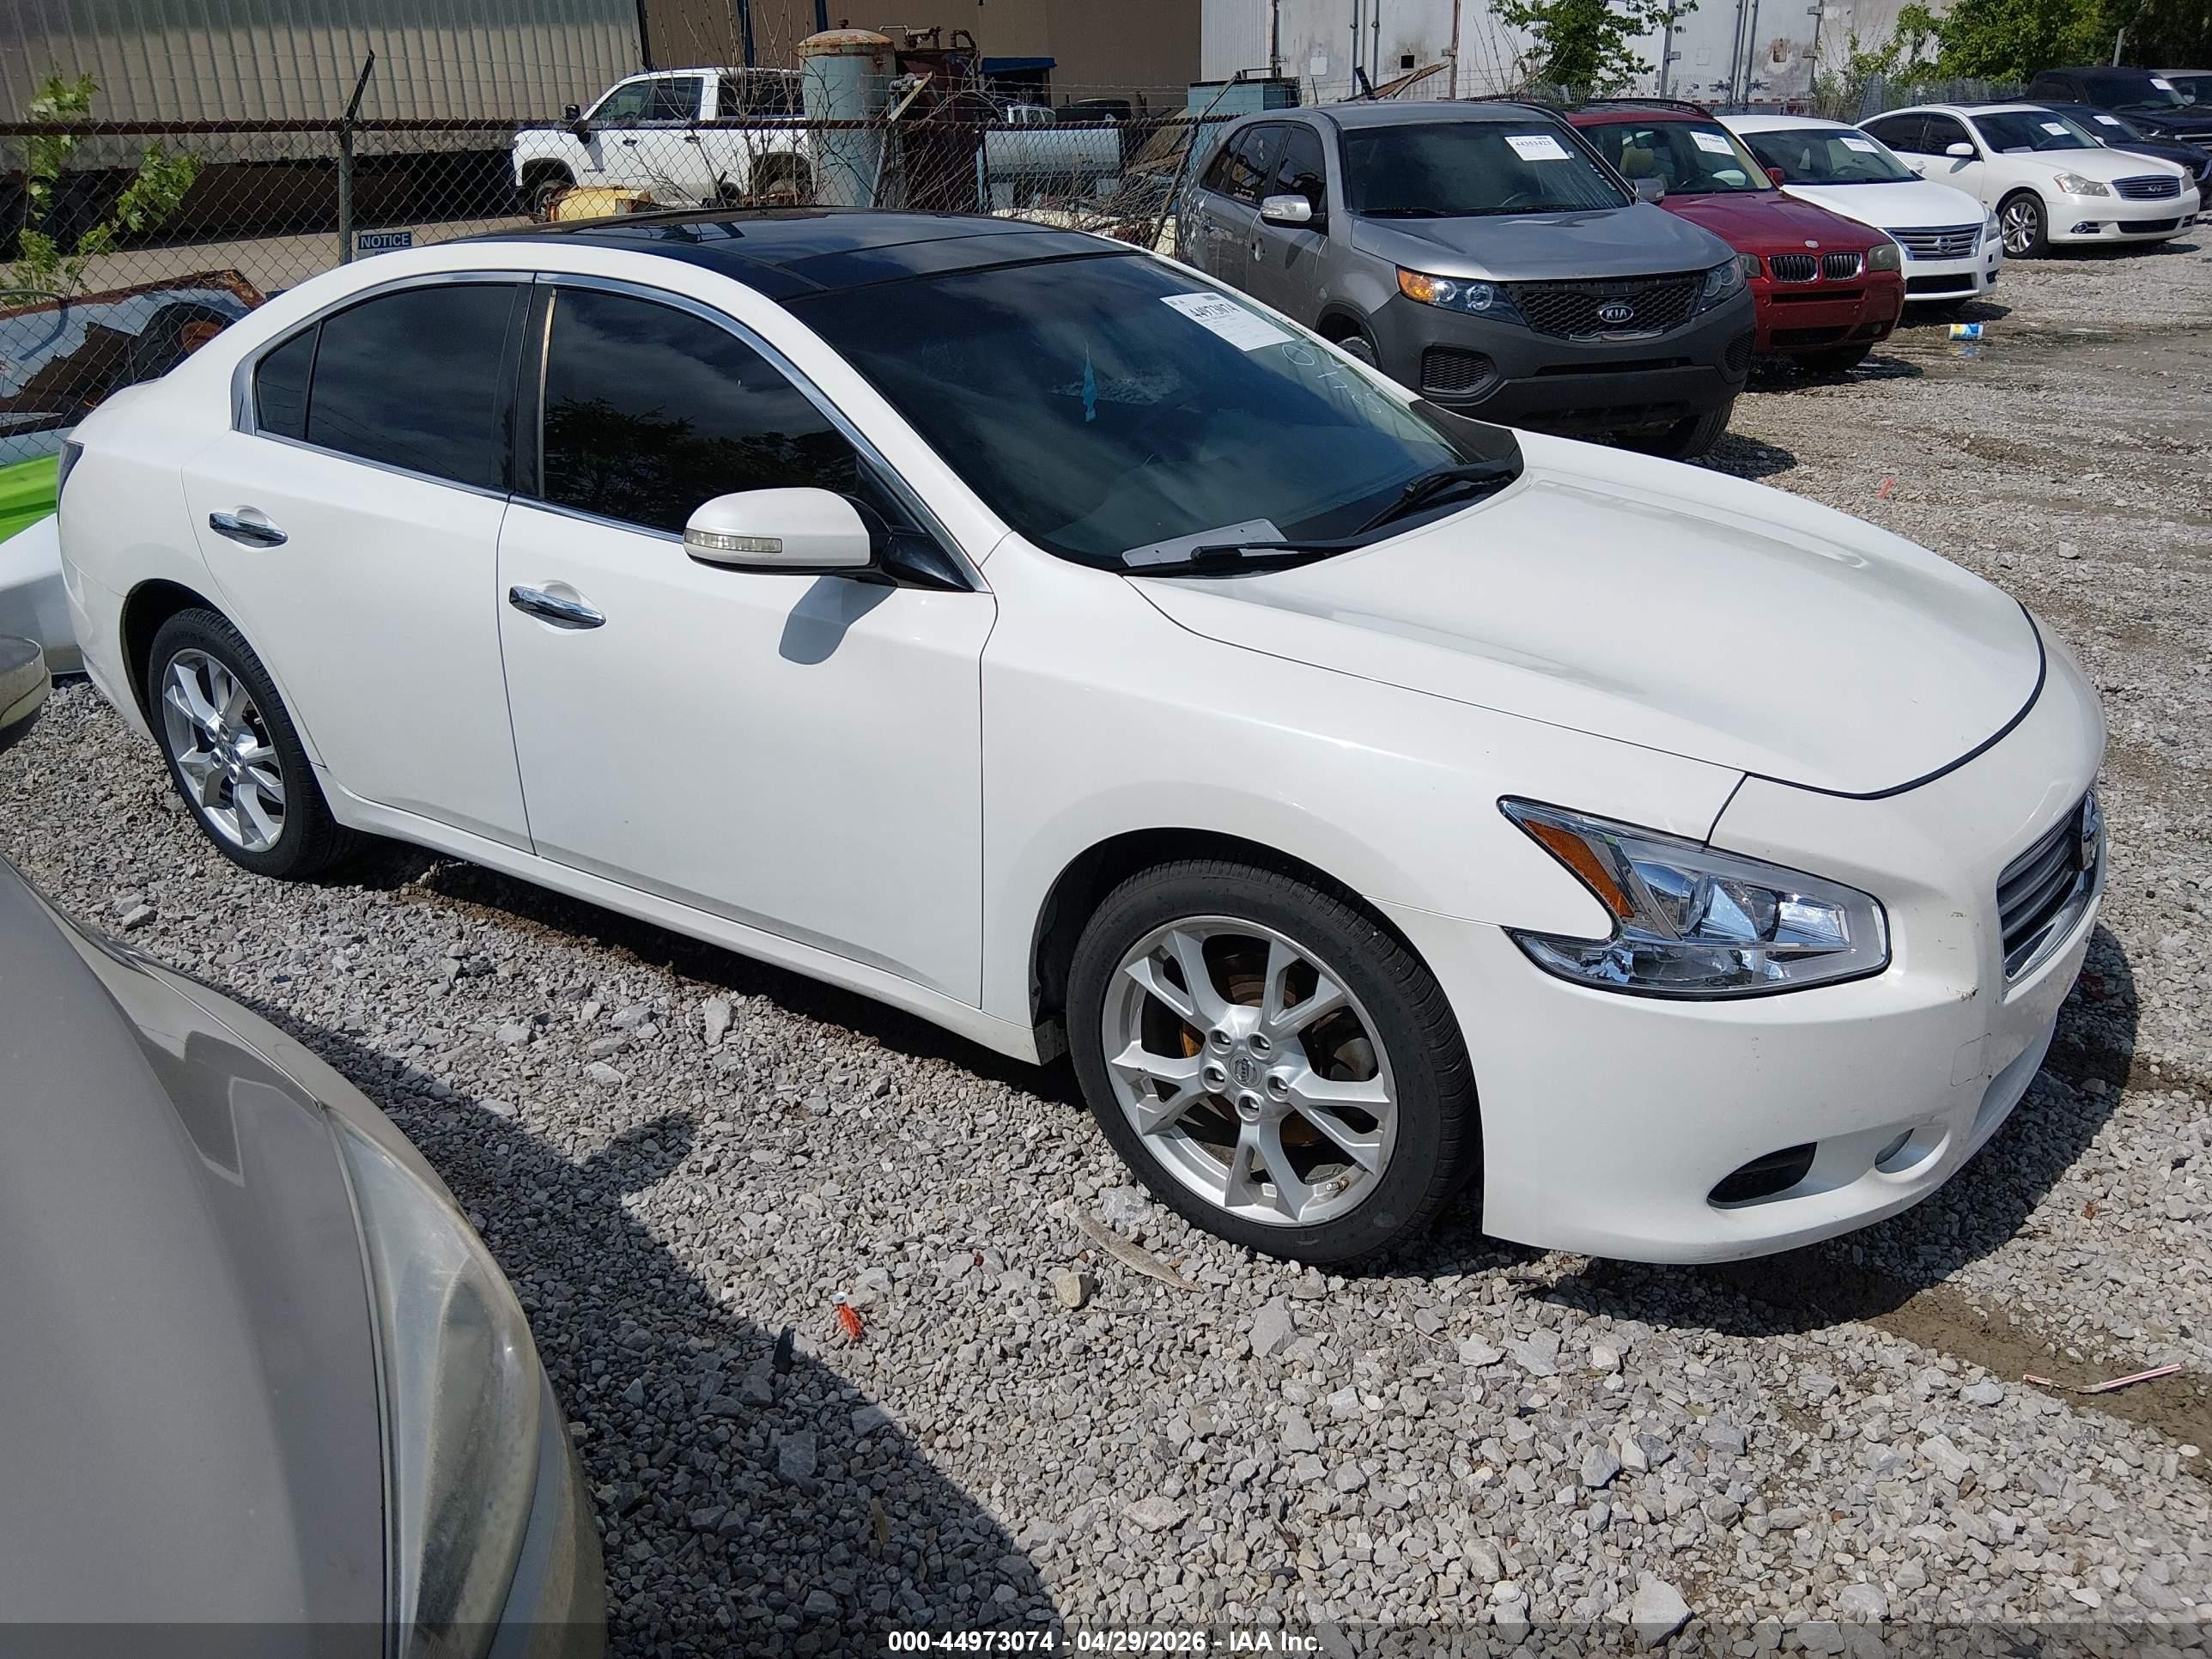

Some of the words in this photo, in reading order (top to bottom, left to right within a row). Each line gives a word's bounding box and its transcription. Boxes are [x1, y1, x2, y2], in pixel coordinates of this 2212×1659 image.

[361, 233, 410, 248] NOTICE
[1188, 302, 1241, 319] 44973074
[1606, 308, 1628, 319] KIA
